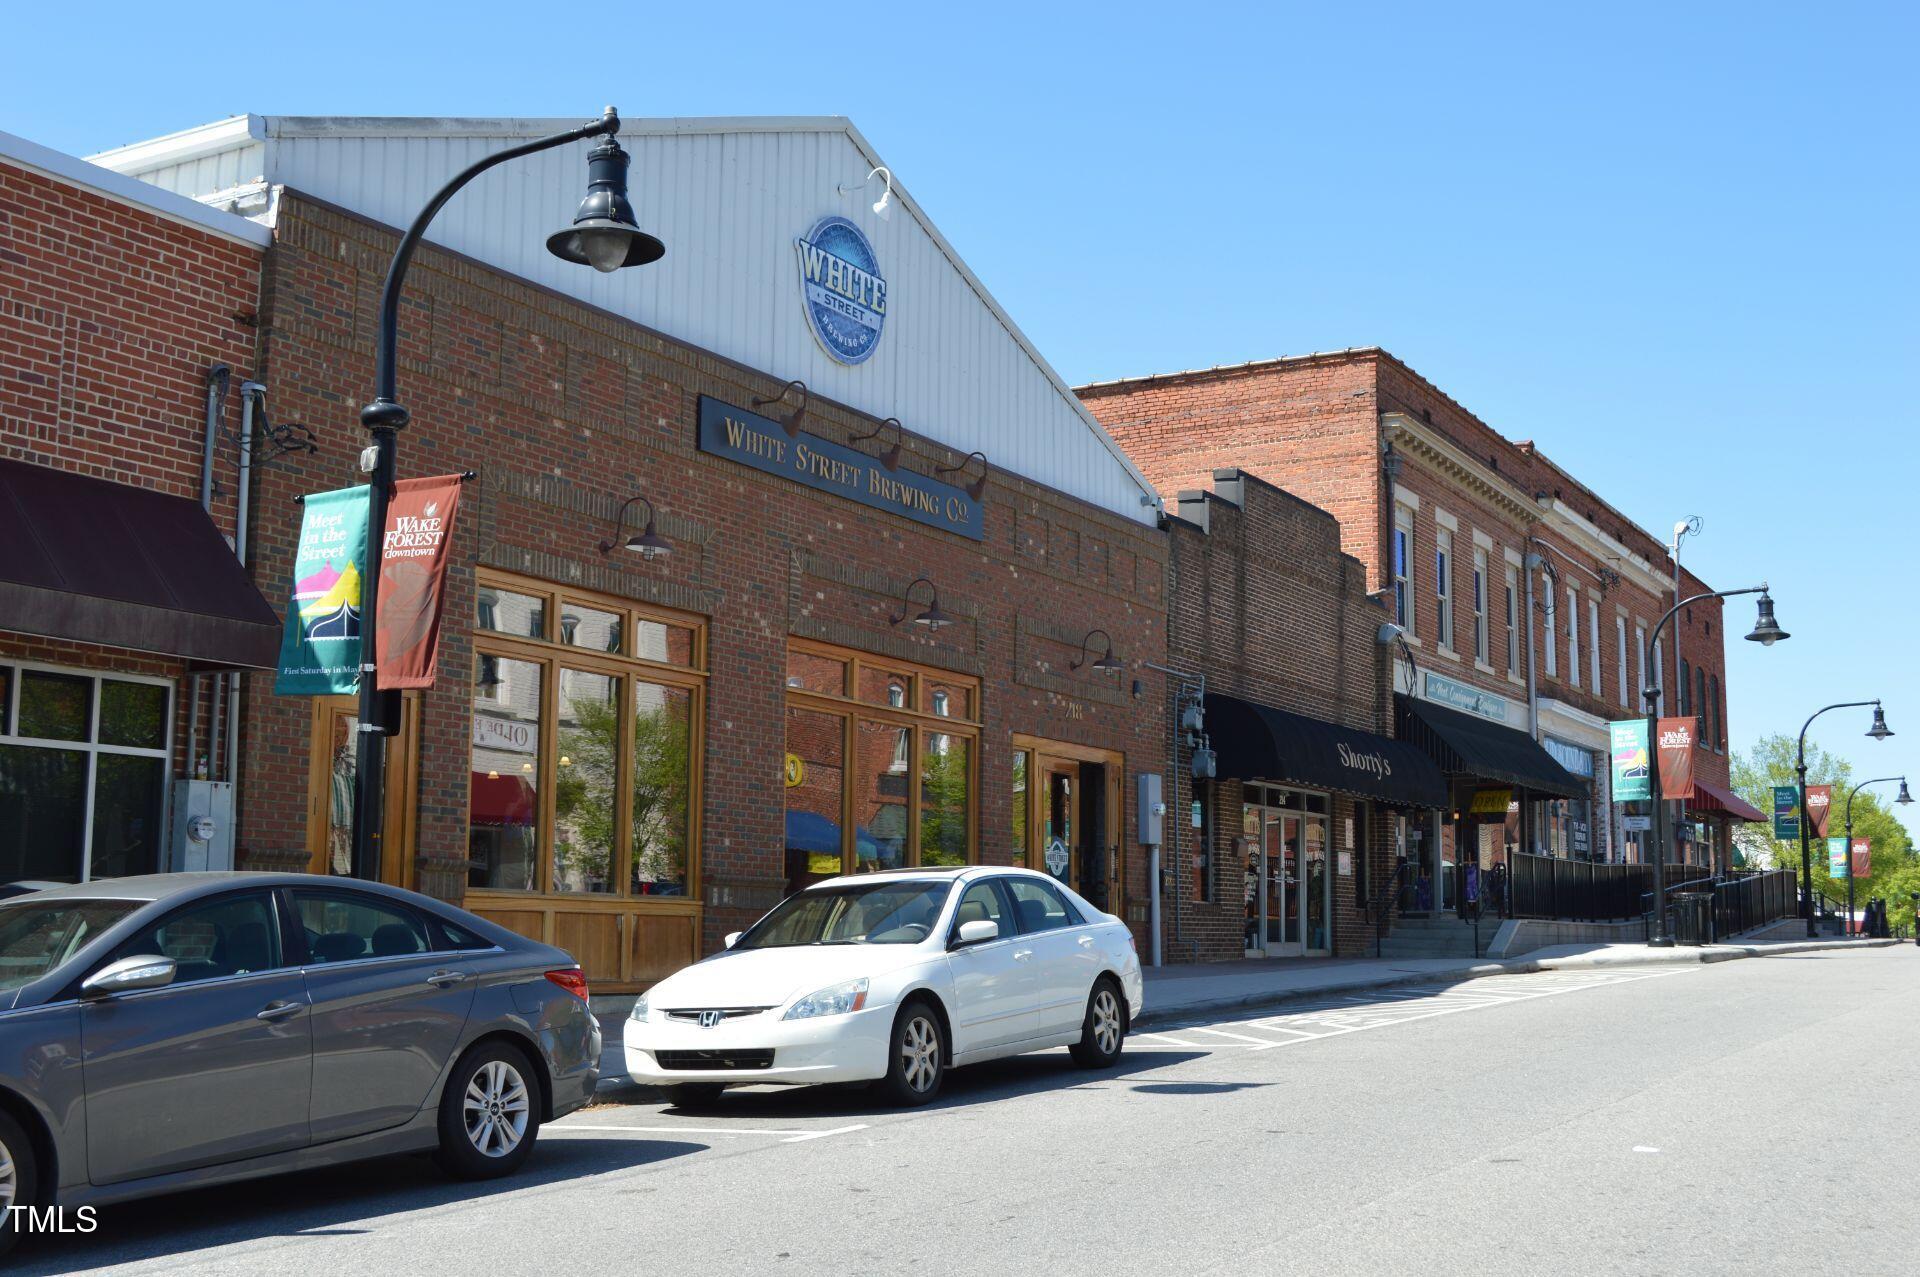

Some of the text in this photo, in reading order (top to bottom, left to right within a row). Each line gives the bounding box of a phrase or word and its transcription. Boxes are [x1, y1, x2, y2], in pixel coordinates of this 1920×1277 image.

[799, 239, 887, 318] WHITE
[824, 293, 866, 321] STREET
[724, 416, 786, 463] WHITE
[795, 443, 861, 488] STREET
[868, 468, 939, 515] BREWING
[308, 512, 345, 529] Meet
[396, 517, 441, 533] WAKE
[304, 528, 346, 544] in the
[384, 531, 443, 550] FOREST
[301, 544, 345, 562] Street
[384, 547, 435, 559] downtown
[300, 666, 331, 676] Saturday
[1660, 737, 1691, 746] FOREST
[1337, 742, 1391, 780] Shorty's
